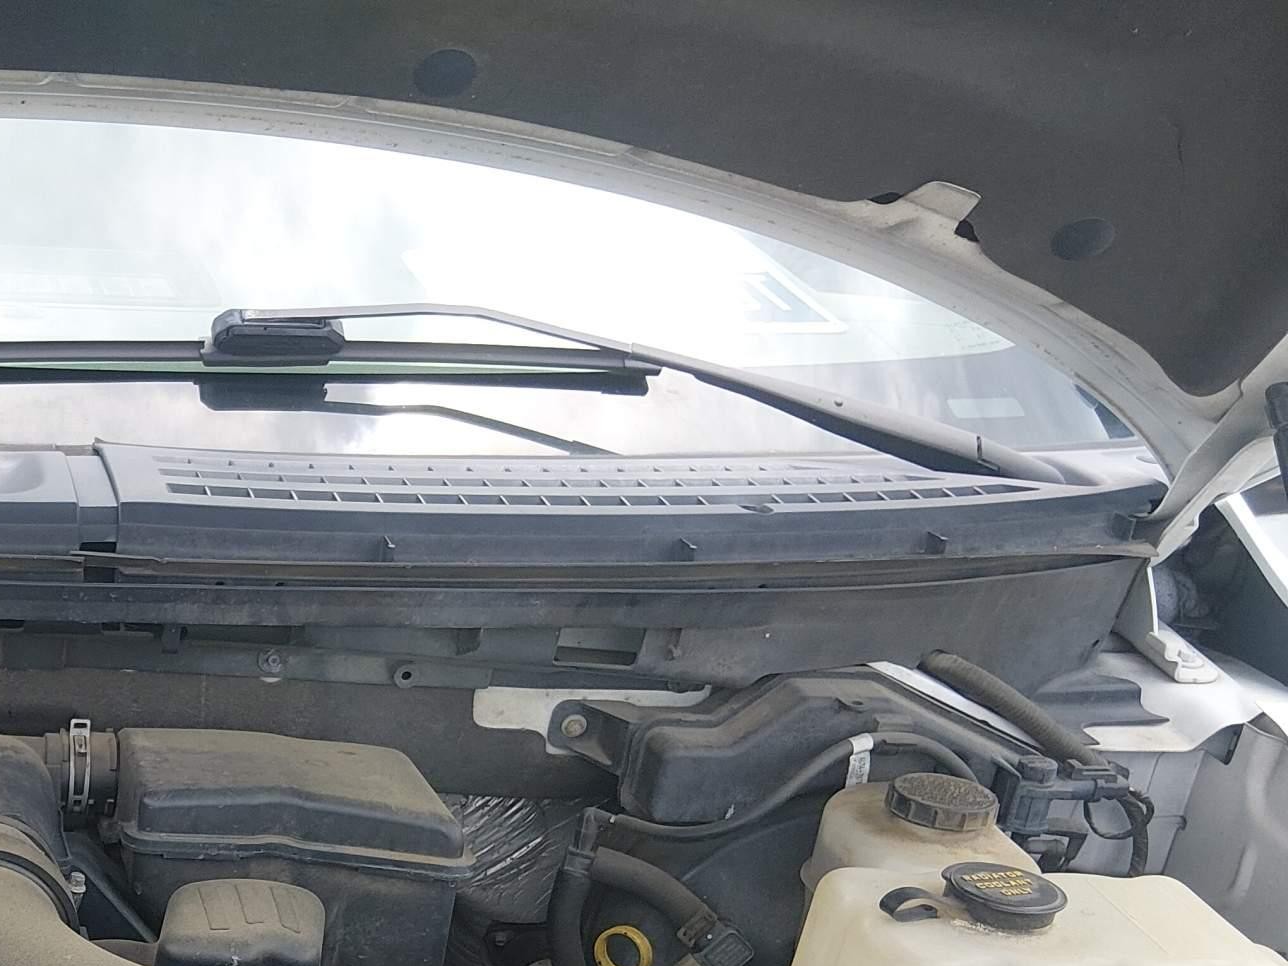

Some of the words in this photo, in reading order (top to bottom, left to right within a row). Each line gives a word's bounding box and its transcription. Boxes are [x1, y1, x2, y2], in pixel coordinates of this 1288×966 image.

[961, 870, 1024, 881] RADIATOR
[975, 878, 1032, 889] COOLANT
[1000, 887, 1033, 896] ONLY
